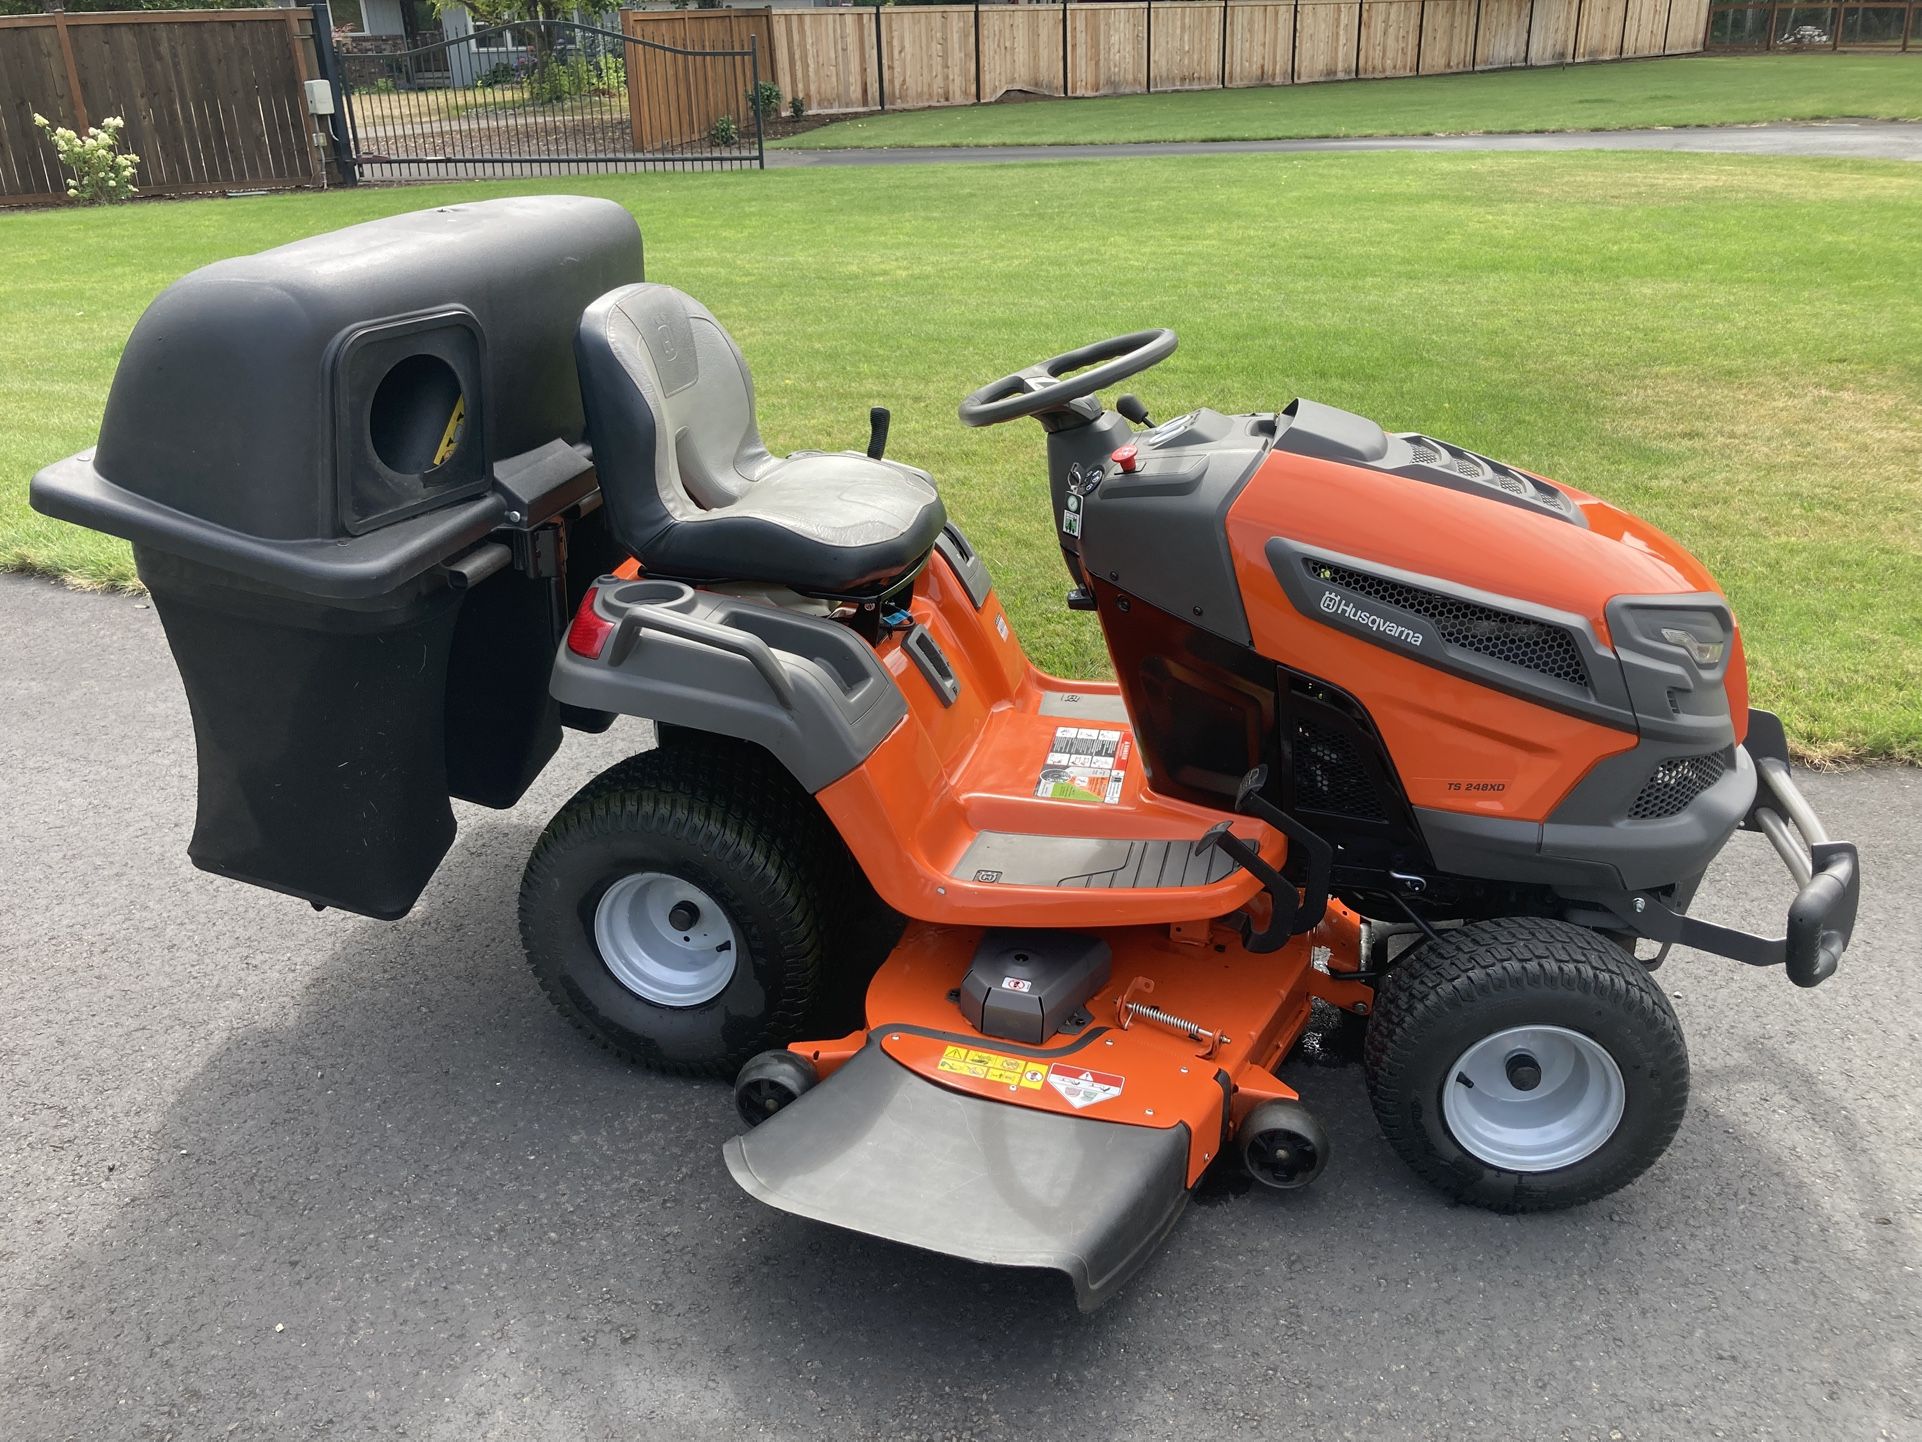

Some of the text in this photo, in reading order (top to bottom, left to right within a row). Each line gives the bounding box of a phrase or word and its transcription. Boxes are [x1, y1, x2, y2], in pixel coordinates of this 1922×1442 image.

[1338, 600, 1423, 646] Husqvarna
[1447, 783, 1505, 792] TS 248XD
